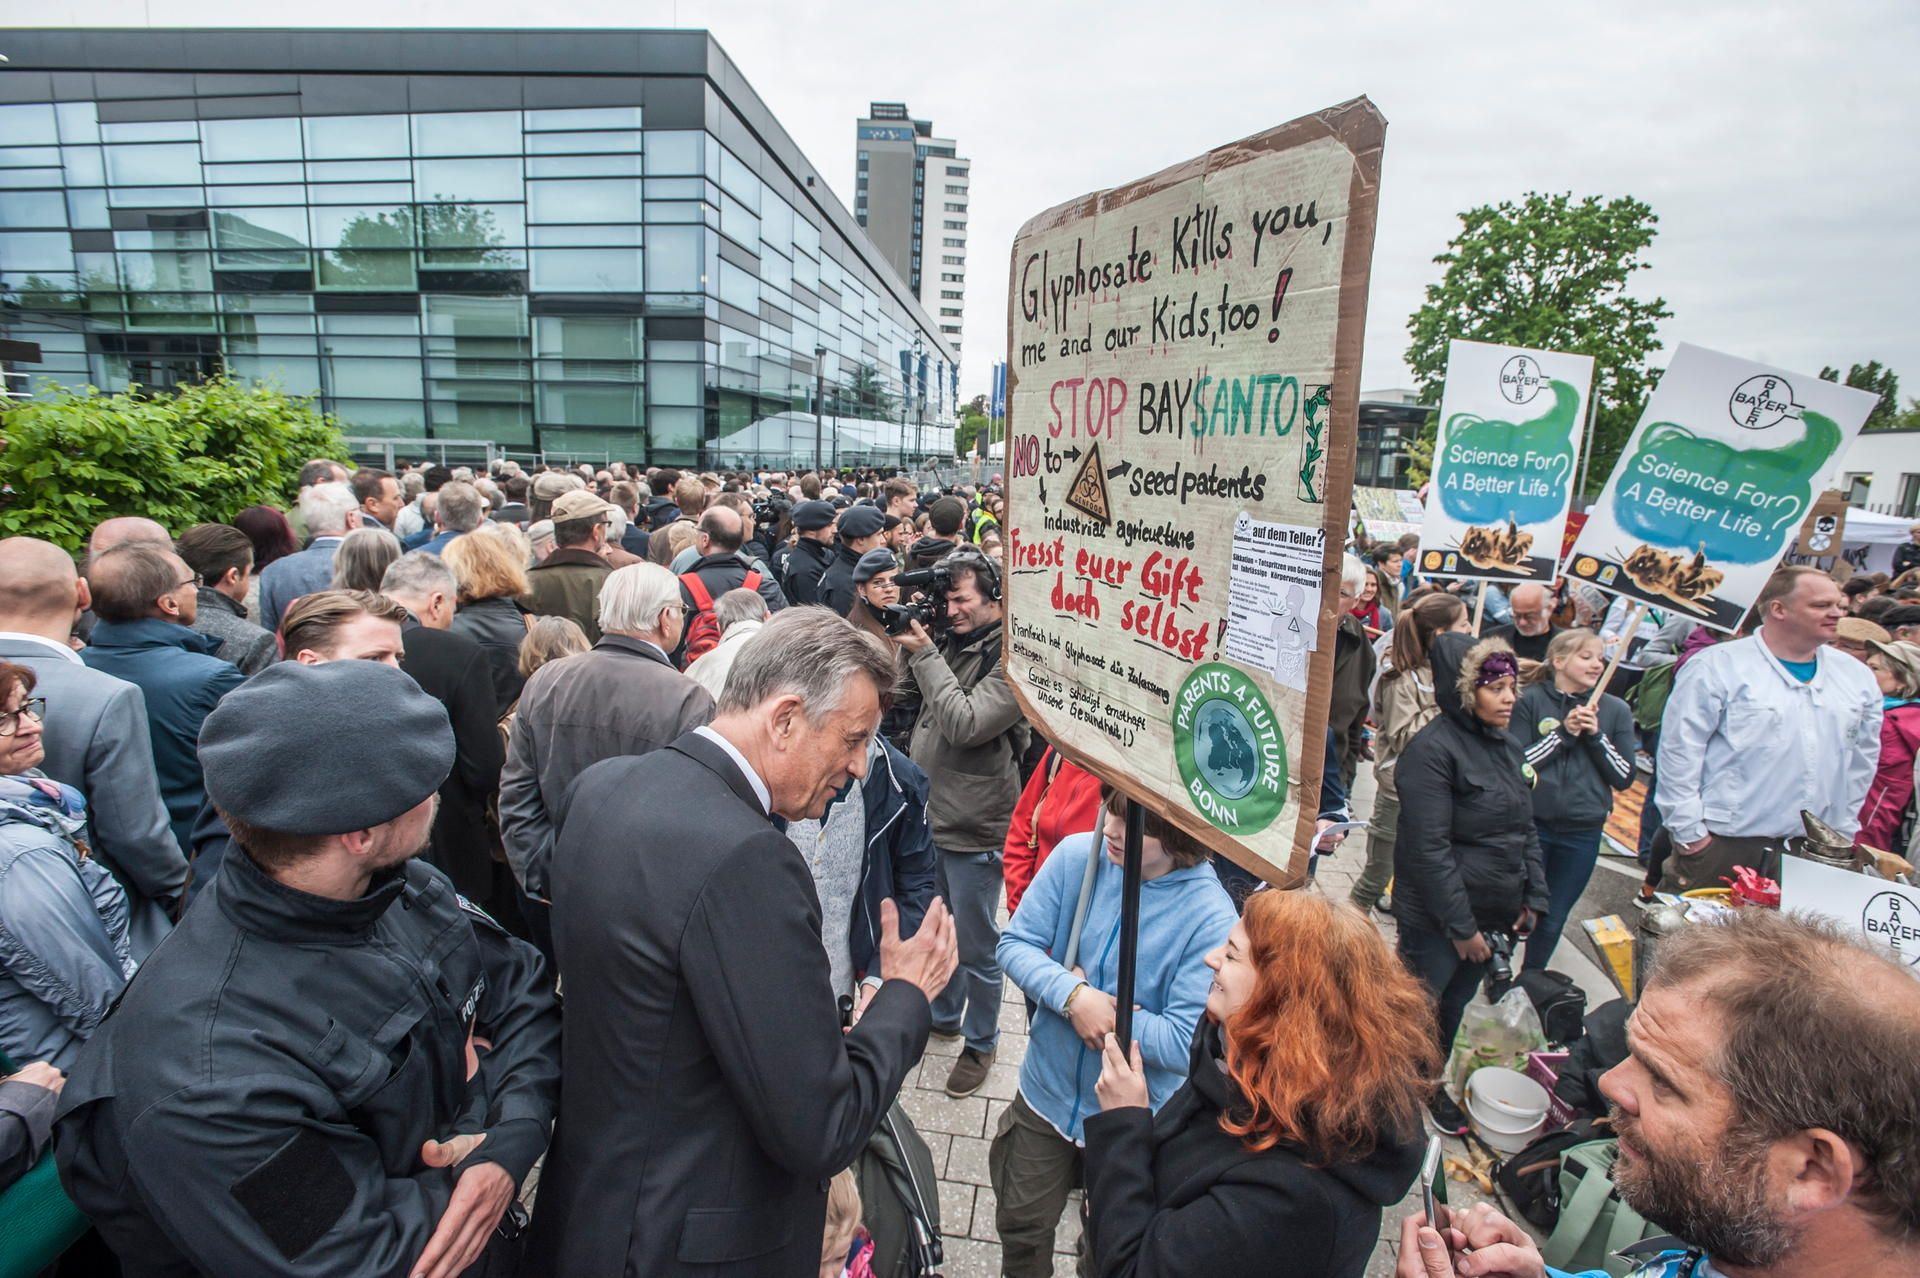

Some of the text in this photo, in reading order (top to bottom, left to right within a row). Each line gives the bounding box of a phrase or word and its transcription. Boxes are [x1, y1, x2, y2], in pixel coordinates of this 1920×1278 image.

[1022, 200, 1332, 334] Glyphosate Kills you,
[1022, 340, 1046, 367] me
[1060, 323, 1091, 356] and
[1105, 324, 1141, 351] our
[1502, 374, 1539, 385] BAYER
[1048, 373, 1299, 439] STOP BAYSANTO
[1735, 392, 1788, 413] BAYER
[1013, 434, 1062, 478] NO to
[1449, 444, 1552, 470] Science For
[1129, 462, 1266, 505] seed patents
[1444, 472, 1458, 490] A
[1462, 472, 1515, 494] Better
[1518, 477, 1549, 497] Life
[1638, 453, 1777, 509] Science For
[1044, 507, 1195, 551] industrial agriculture
[1622, 482, 1641, 501] A
[1646, 487, 1717, 523] Better
[1718, 509, 1762, 537] Life
[1253, 526, 1267, 538] auf
[1267, 527, 1287, 542] dem
[1010, 528, 1204, 609] Fresst euer Gift
[1287, 565, 1297, 573] von
[1051, 571, 1100, 621] doch
[1049, 632, 1061, 650] hat
[1110, 660, 1124, 677] die
[1053, 681, 1063, 693] es
[1177, 671, 1281, 794] PARENTS 4 FUTURE
[1189, 776, 1240, 828] BONN
